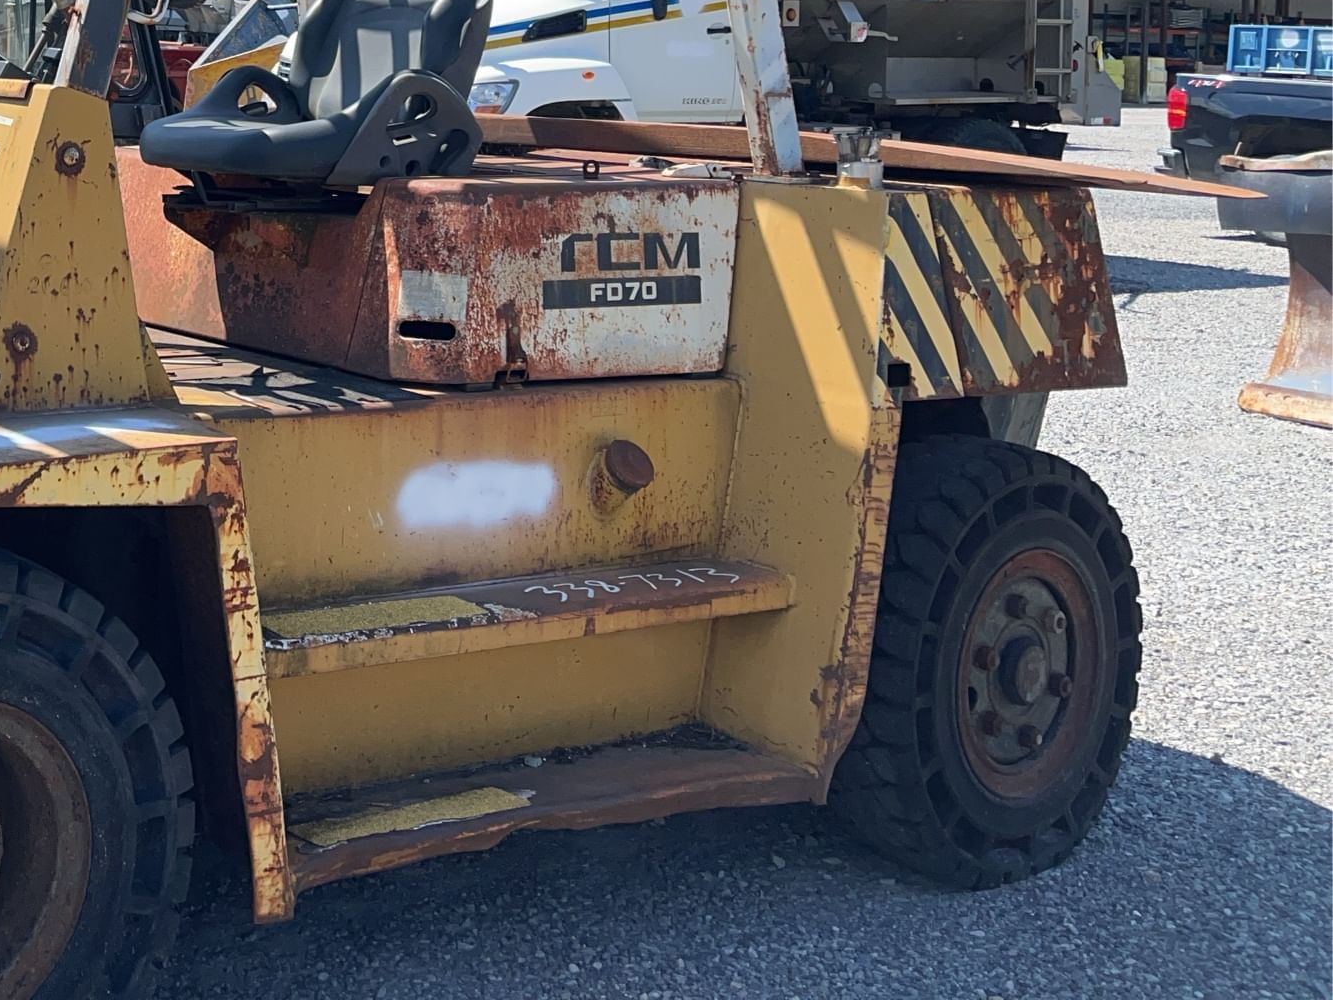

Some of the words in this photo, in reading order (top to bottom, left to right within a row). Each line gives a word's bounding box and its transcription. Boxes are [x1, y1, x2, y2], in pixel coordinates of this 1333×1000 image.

[560, 231, 701, 273] TCM
[589, 280, 658, 303] FD70
[523, 567, 740, 603] 338-7313
